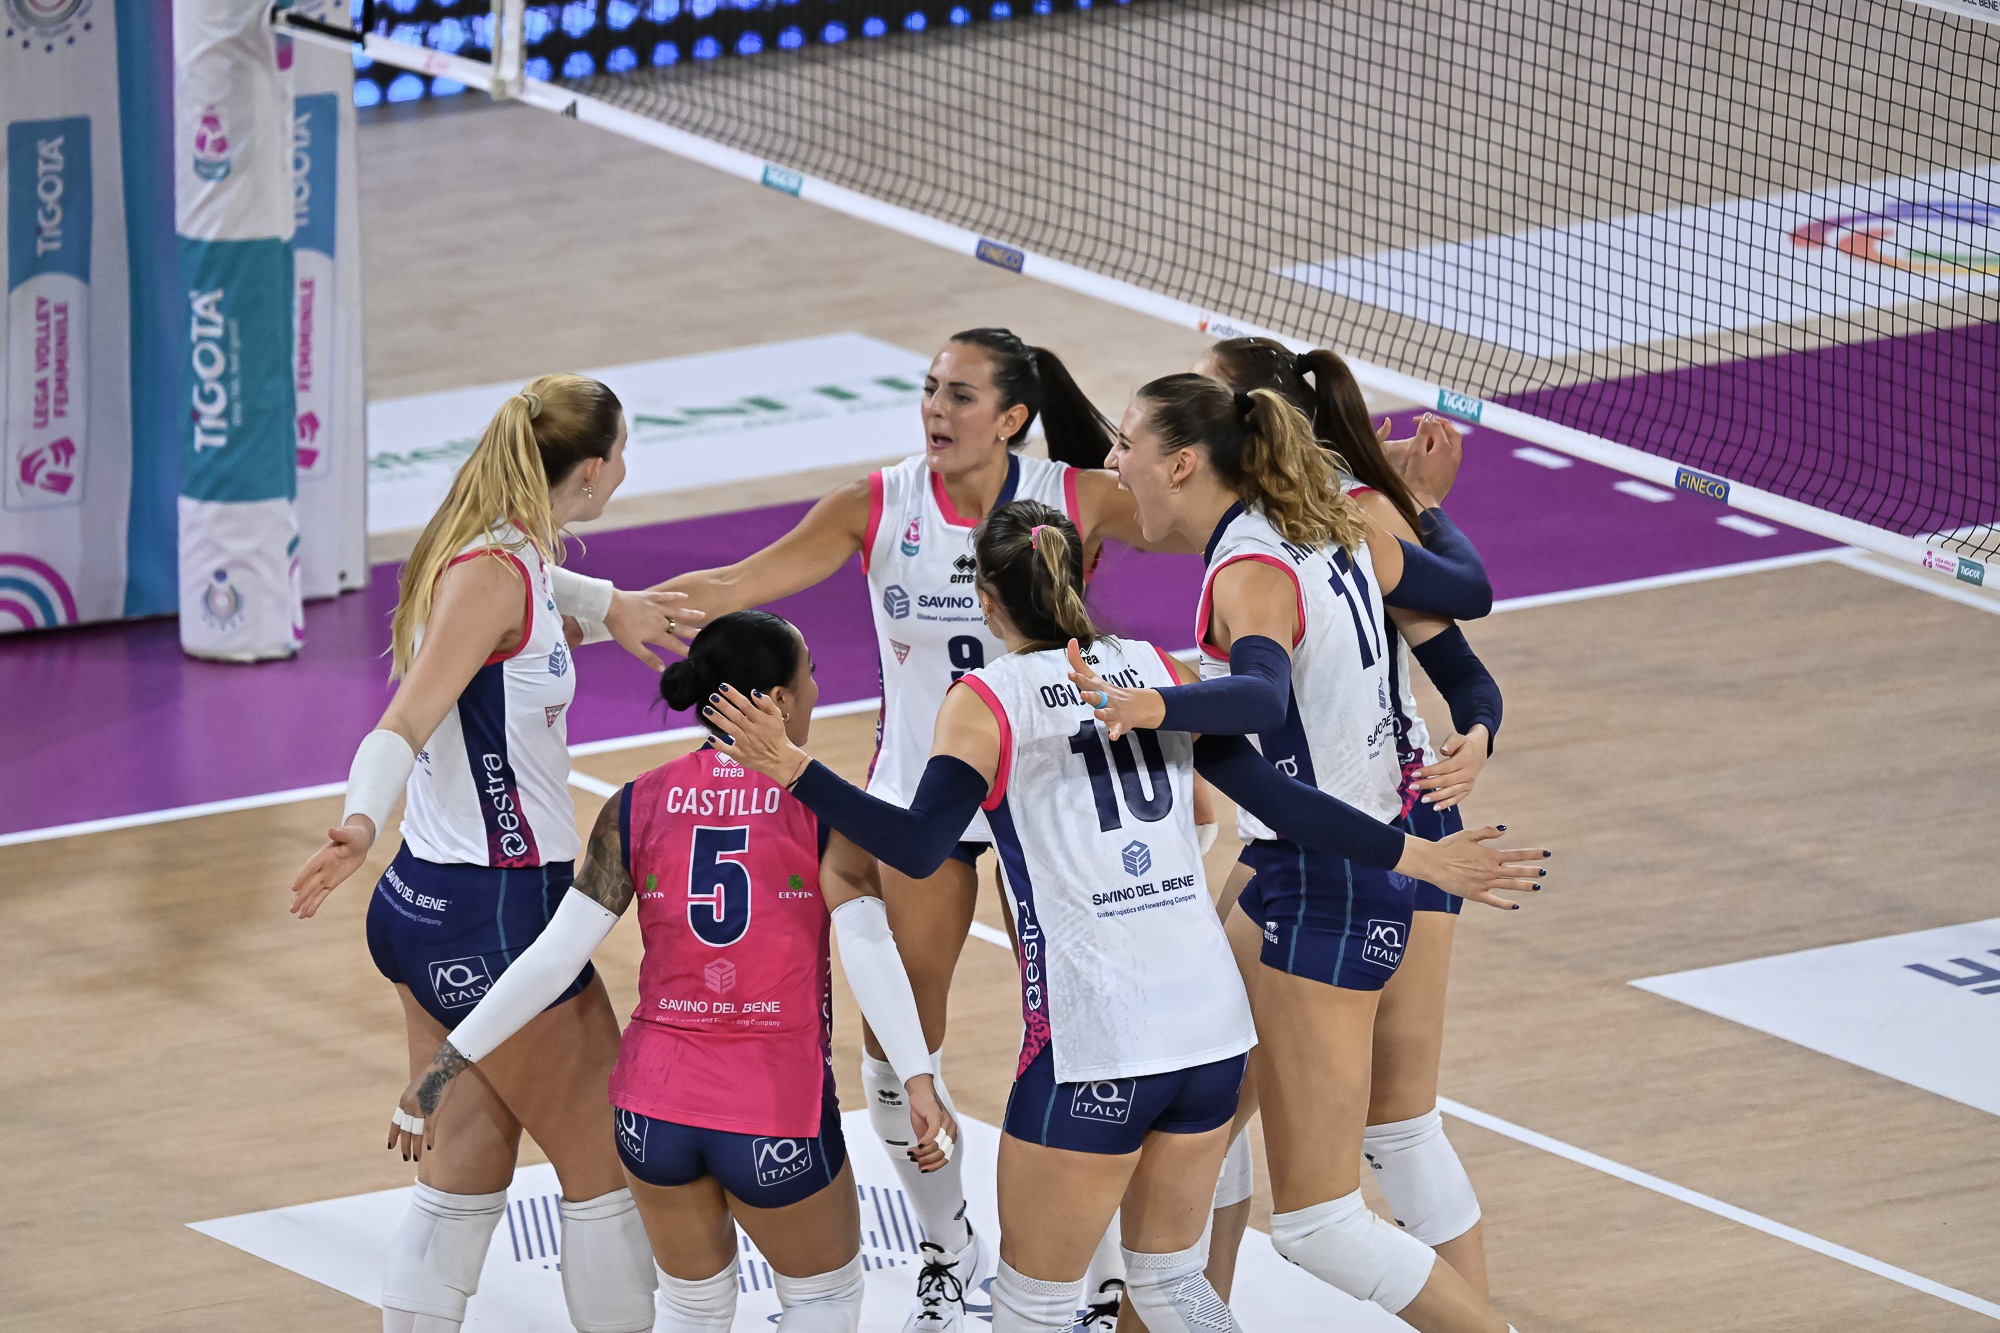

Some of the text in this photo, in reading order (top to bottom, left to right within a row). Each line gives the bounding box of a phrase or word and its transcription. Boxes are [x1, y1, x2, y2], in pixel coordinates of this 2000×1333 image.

[33, 297, 50, 429] LEGA VOLLEY
[53, 303, 69, 418] FEMMINILE
[1679, 472, 1726, 500] FINECO
[950, 573, 977, 584] erre
[918, 595, 974, 609] SAVINO
[1327, 545, 1381, 671] 17
[917, 613, 938, 621] Global
[939, 614, 969, 623] Logistics
[947, 635, 985, 683] 9
[1068, 718, 1173, 833] 10
[666, 786, 781, 817] CASTILLO
[385, 865, 404, 894] SAVINO
[401, 886, 415, 904] DEL
[415, 893, 448, 912] BENE
[687, 825, 751, 947] 5
[1092, 874, 1195, 906] SAVINO DEL BENE
[1144, 897, 1175, 910] Forwarding
[1174, 893, 1197, 904] Company
[1367, 944, 1401, 964] ITALY
[441, 983, 490, 1004] ITALY
[658, 998, 781, 1014] SAVINO DEL BENE
[750, 1018, 781, 1028] Company
[1076, 1101, 1126, 1118] ITALY
[762, 1156, 808, 1182] ITALY
